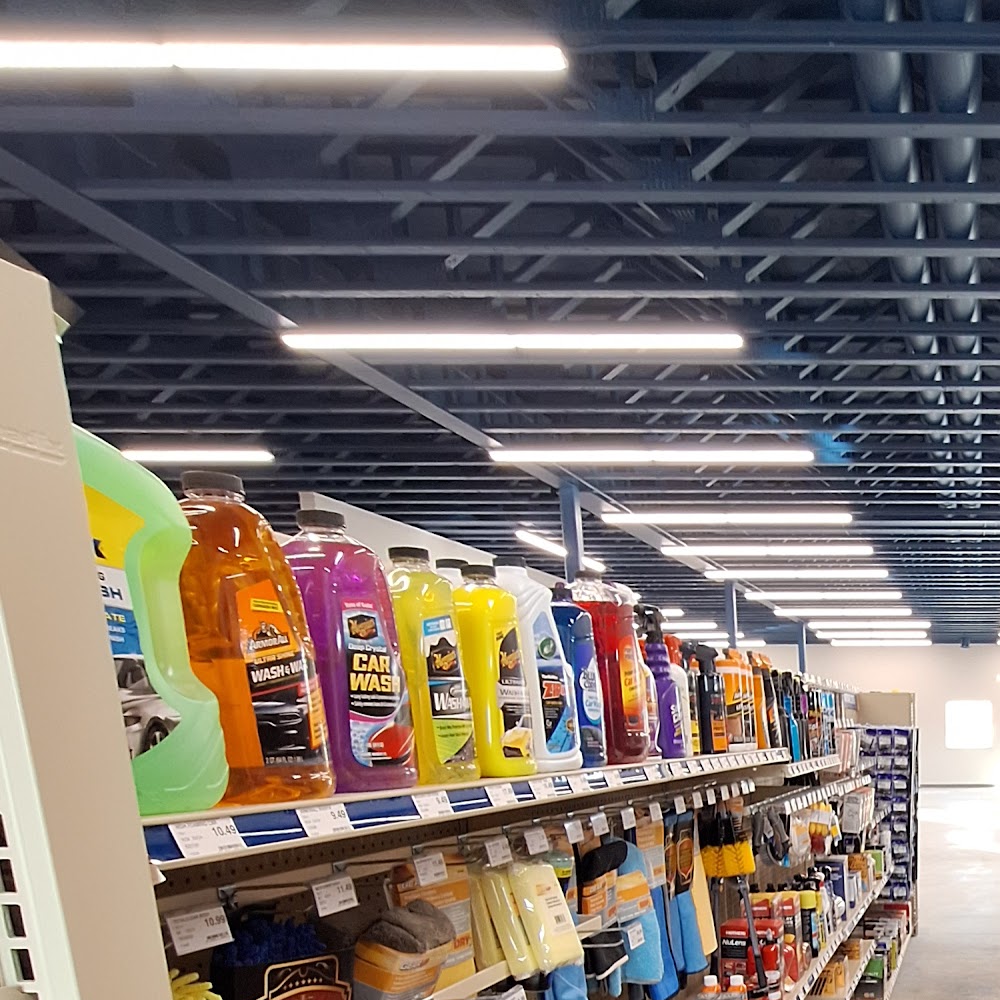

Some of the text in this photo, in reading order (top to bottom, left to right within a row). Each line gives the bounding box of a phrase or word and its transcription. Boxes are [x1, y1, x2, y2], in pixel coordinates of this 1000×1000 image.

[353, 653, 390, 673] CAR
[250, 664, 285, 683] WASH
[350, 672, 400, 693] WASH
[212, 824, 237, 837] 10.49
[204, 915, 226, 929] 10.99
